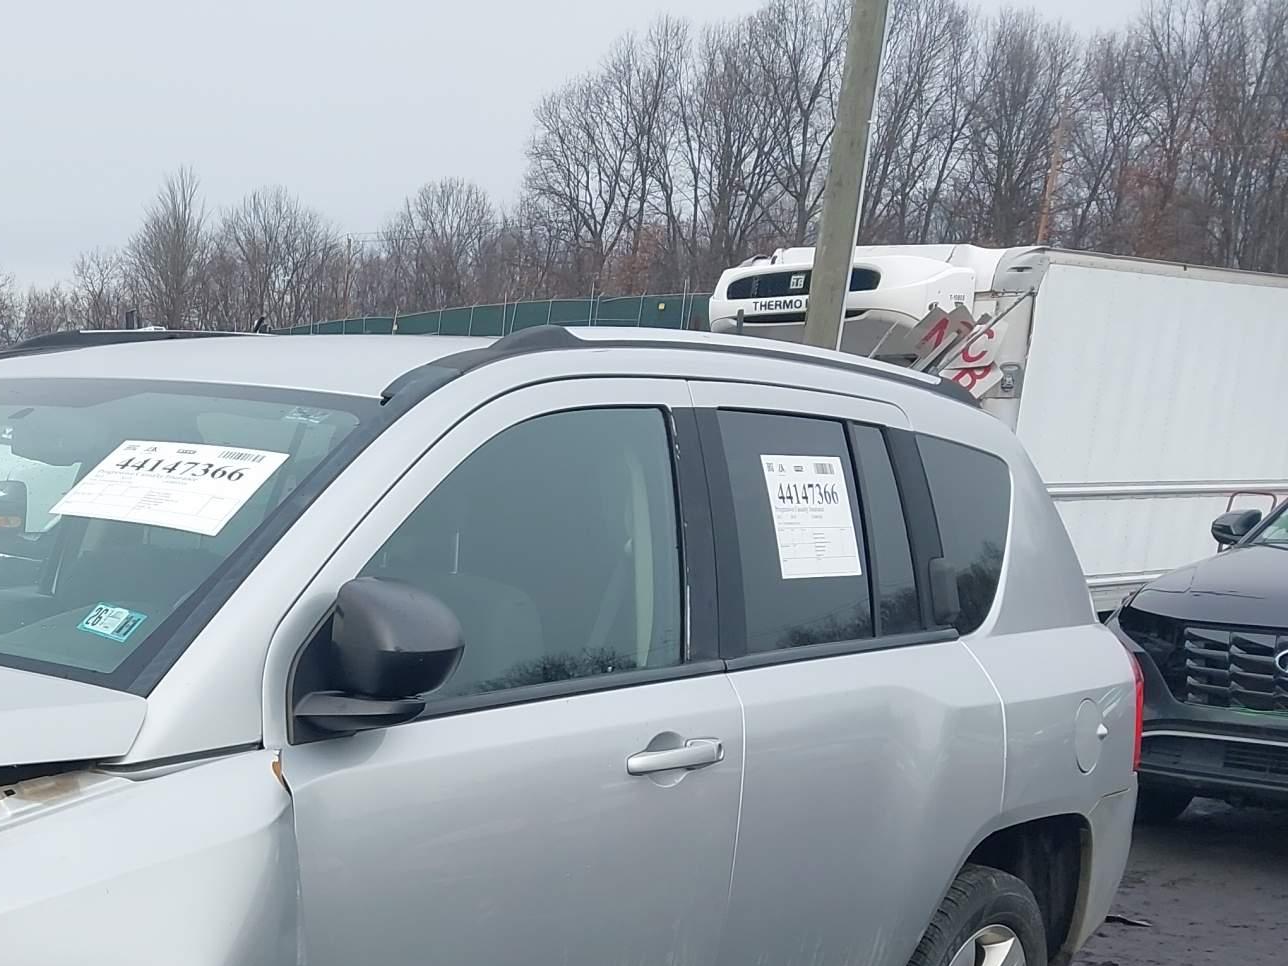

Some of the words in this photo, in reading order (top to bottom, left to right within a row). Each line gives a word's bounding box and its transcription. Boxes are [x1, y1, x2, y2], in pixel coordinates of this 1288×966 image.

[752, 299, 802, 311] THERMO
[115, 457, 249, 482] 44147366
[777, 482, 839, 505] 44147366
[85, 606, 109, 626] 26
